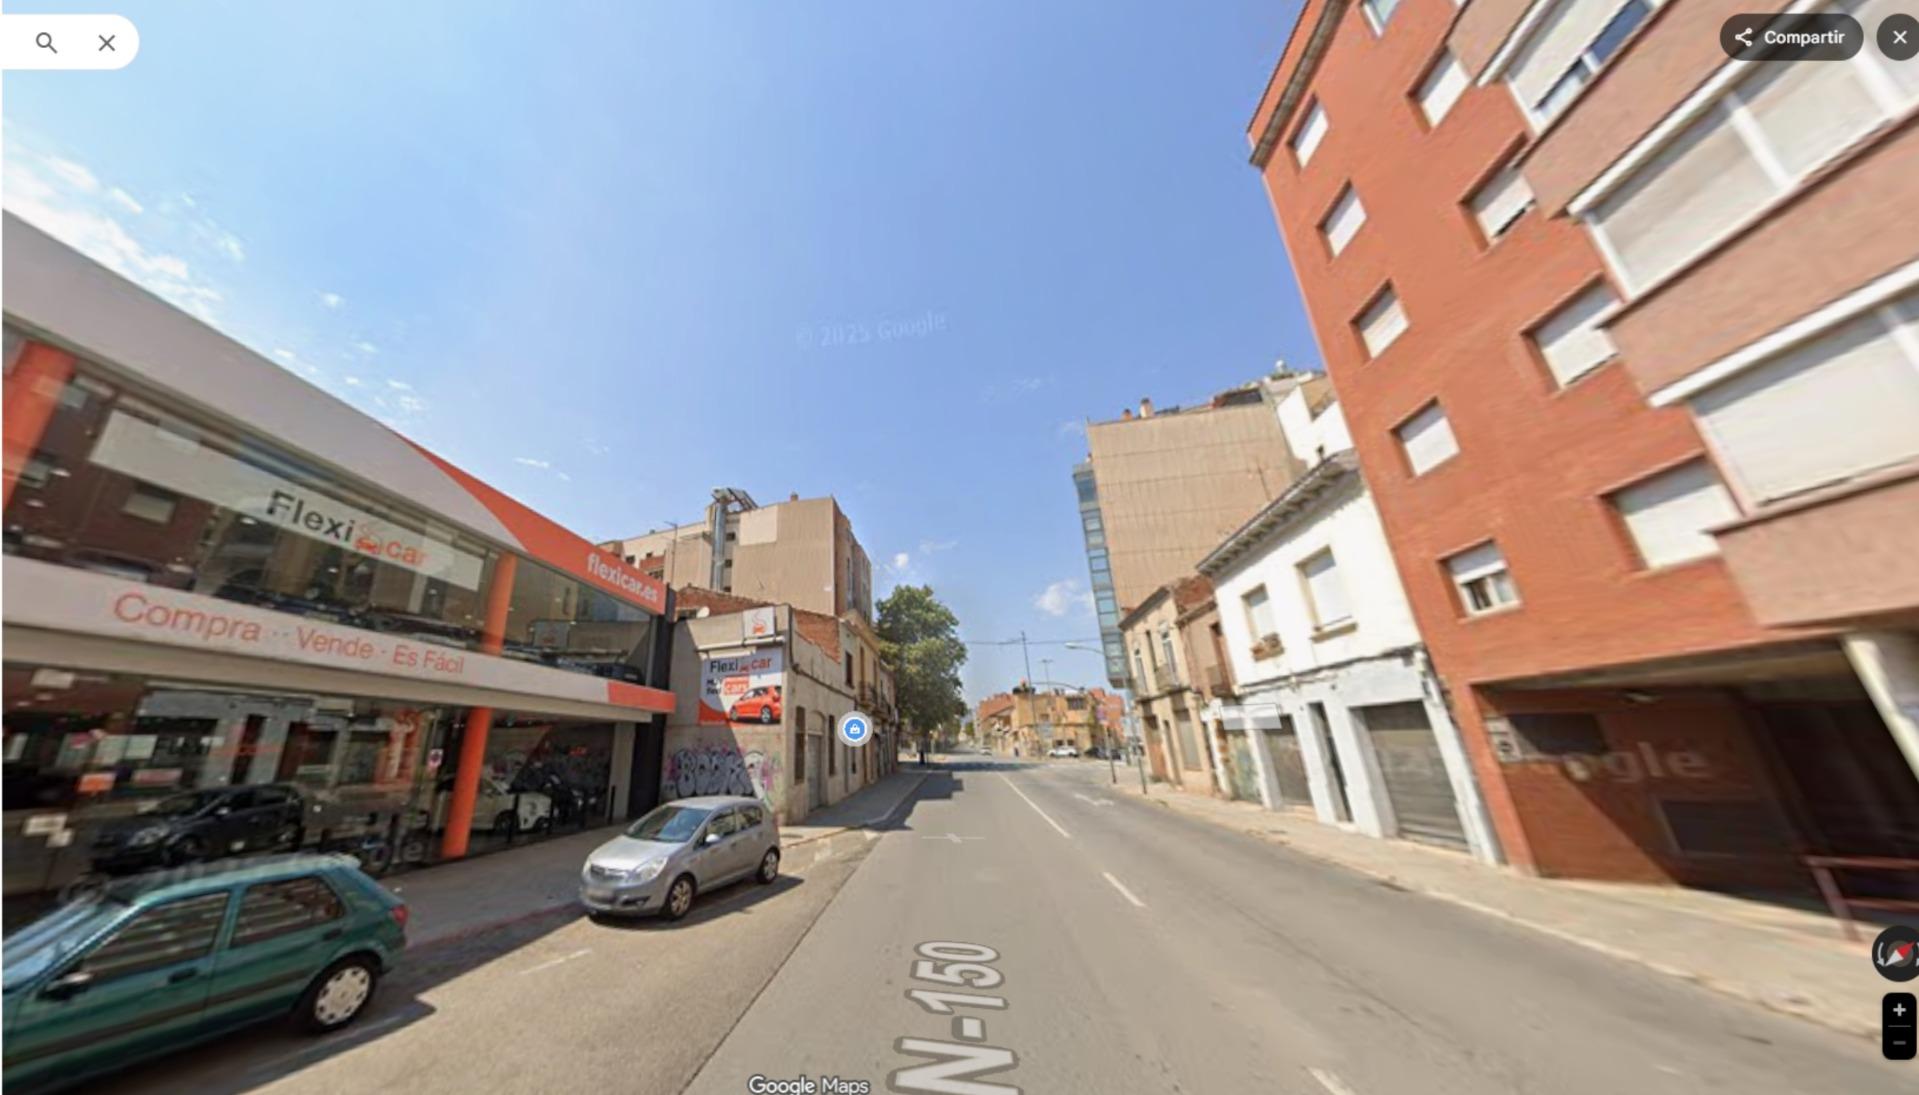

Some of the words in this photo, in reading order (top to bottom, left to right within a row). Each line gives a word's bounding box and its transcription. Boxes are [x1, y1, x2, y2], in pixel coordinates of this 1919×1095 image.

[266, 489, 356, 543] Flexi
[386, 541, 430, 568] car
[587, 552, 658, 603] flexicar.es
[113, 591, 263, 642] Compra
[296, 625, 375, 660] Vende
[393, 644, 418, 668] Es
[423, 649, 465, 675] Fácil
[709, 658, 738, 673] Flexi
